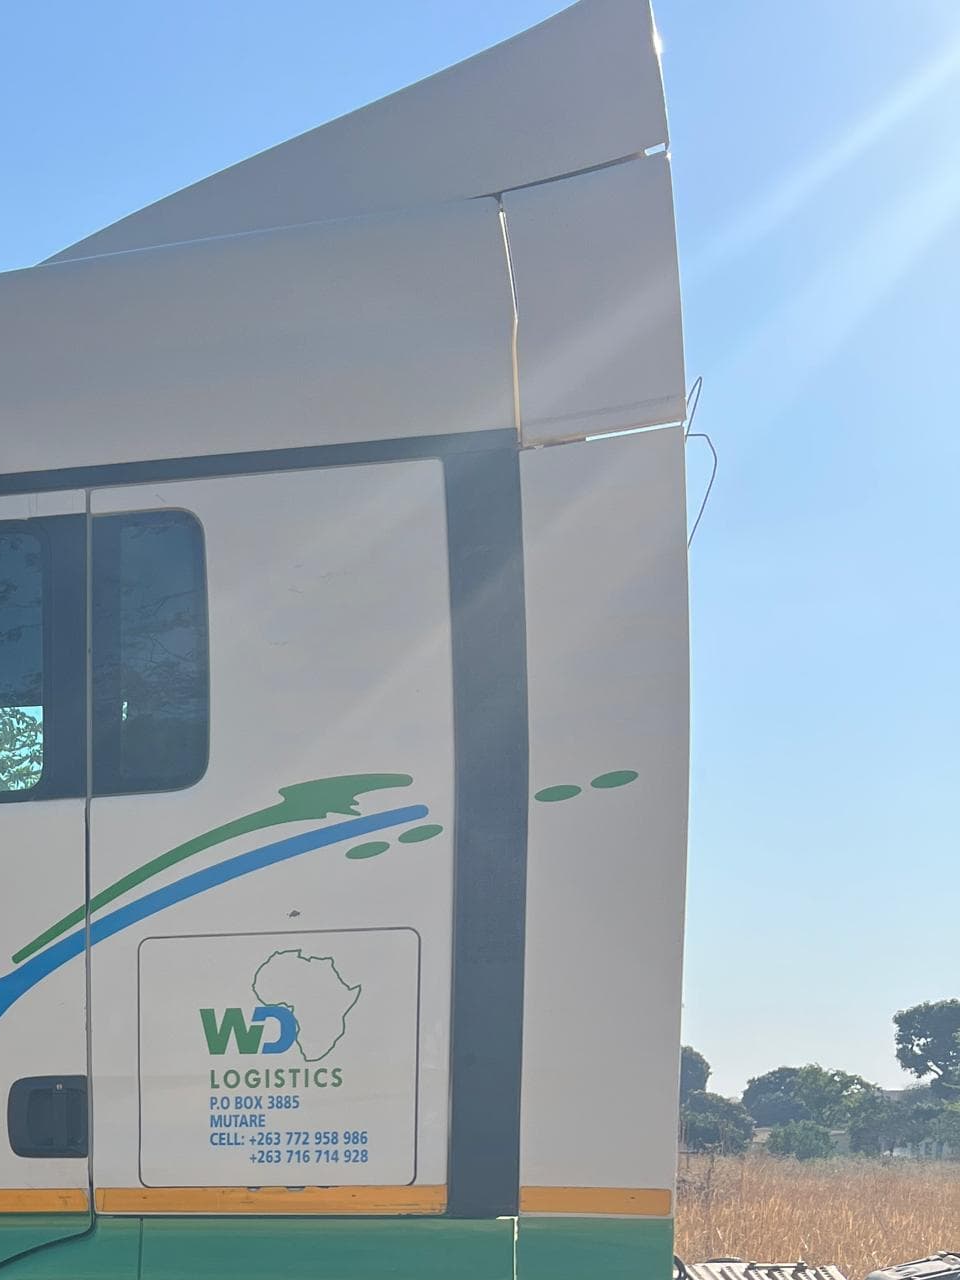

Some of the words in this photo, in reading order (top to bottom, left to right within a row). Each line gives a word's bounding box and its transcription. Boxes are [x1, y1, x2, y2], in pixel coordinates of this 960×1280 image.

[199, 1006, 297, 1055] WD
[209, 1068, 344, 1089] LOGISTICS
[209, 1096, 231, 1110] P.O
[234, 1096, 263, 1110] BOX
[267, 1095, 300, 1109] 3885
[209, 1114, 266, 1128] MUTARE
[209, 1132, 245, 1146] CELL:
[249, 1132, 281, 1146] +263
[286, 1132, 310, 1145] 772
[314, 1131, 339, 1145] 958
[343, 1131, 368, 1145] 986
[249, 1150, 282, 1164] +263
[286, 1150, 310, 1163] 716
[315, 1150, 340, 1163] 714
[344, 1149, 369, 1163] 928
